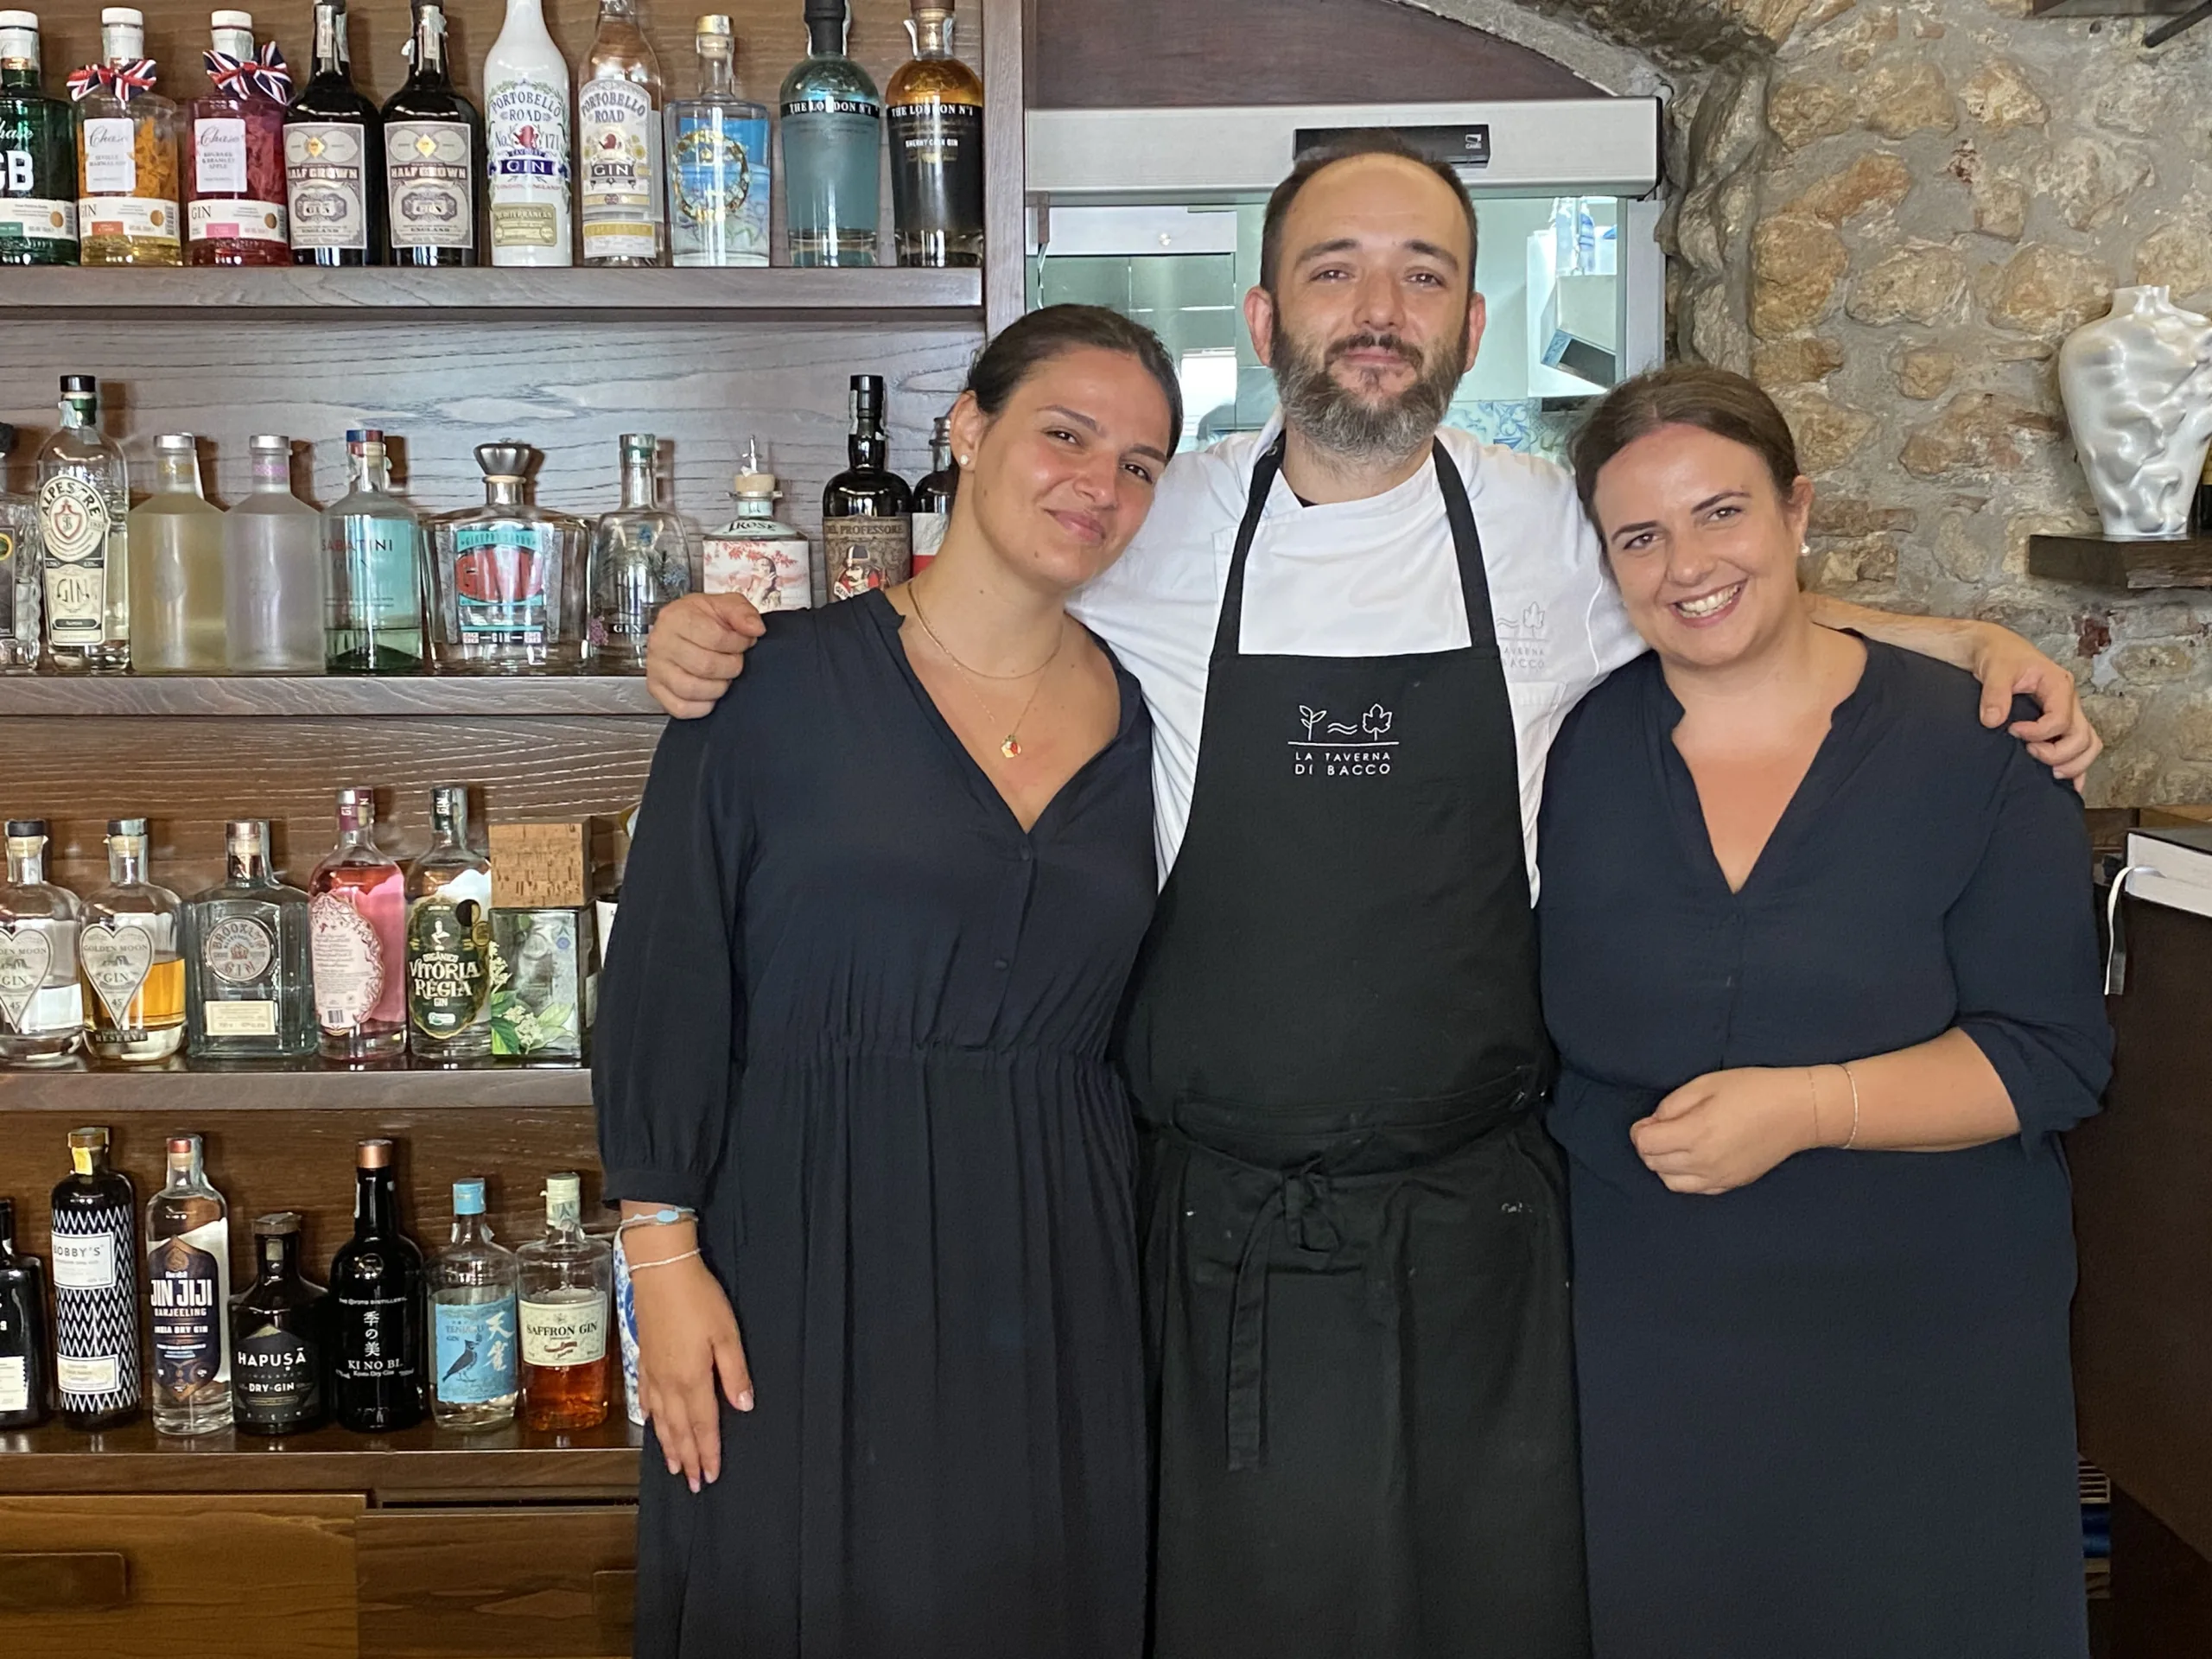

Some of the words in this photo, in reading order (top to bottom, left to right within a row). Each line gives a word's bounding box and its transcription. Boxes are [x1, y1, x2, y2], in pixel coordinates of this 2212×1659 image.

[491, 91, 561, 118] PORTOBELLO
[581, 92, 645, 118] PORTOBELLO
[790, 102, 807, 114] THE
[808, 98, 855, 113] LODON
[594, 110, 625, 123] ROAD
[892, 106, 907, 118] THE
[909, 105, 955, 118] LONON
[0, 119, 34, 139] hase
[545, 133, 559, 150] 171
[0, 149, 34, 191] B
[506, 160, 544, 173] GIN
[594, 164, 629, 175] GIN
[191, 206, 211, 219] GIN
[41, 481, 101, 517] ALPESTRE
[840, 524, 903, 535] PROFESSORE
[57, 577, 90, 603] GIN
[613, 624, 642, 633] GIN
[492, 632, 511, 643] GIN
[1296, 752, 1313, 760] LA
[1325, 752, 1390, 761] TAVERNA
[1295, 764, 1313, 775] DI
[1327, 764, 1390, 776] BACCO
[225, 961, 256, 977] GIN
[2, 976, 27, 985] GIN
[104, 973, 129, 982] GIN
[433, 997, 448, 1007] GIN
[150, 1279, 174, 1306] JIN
[176, 1279, 213, 1306] JIJI
[154, 1307, 207, 1317] DARJEELING
[363, 1311, 380, 1357] 季の美
[525, 1323, 575, 1336] SAFFRON
[578, 1321, 598, 1334] GIN
[348, 1360, 360, 1370] KI
[364, 1361, 384, 1370] NO
